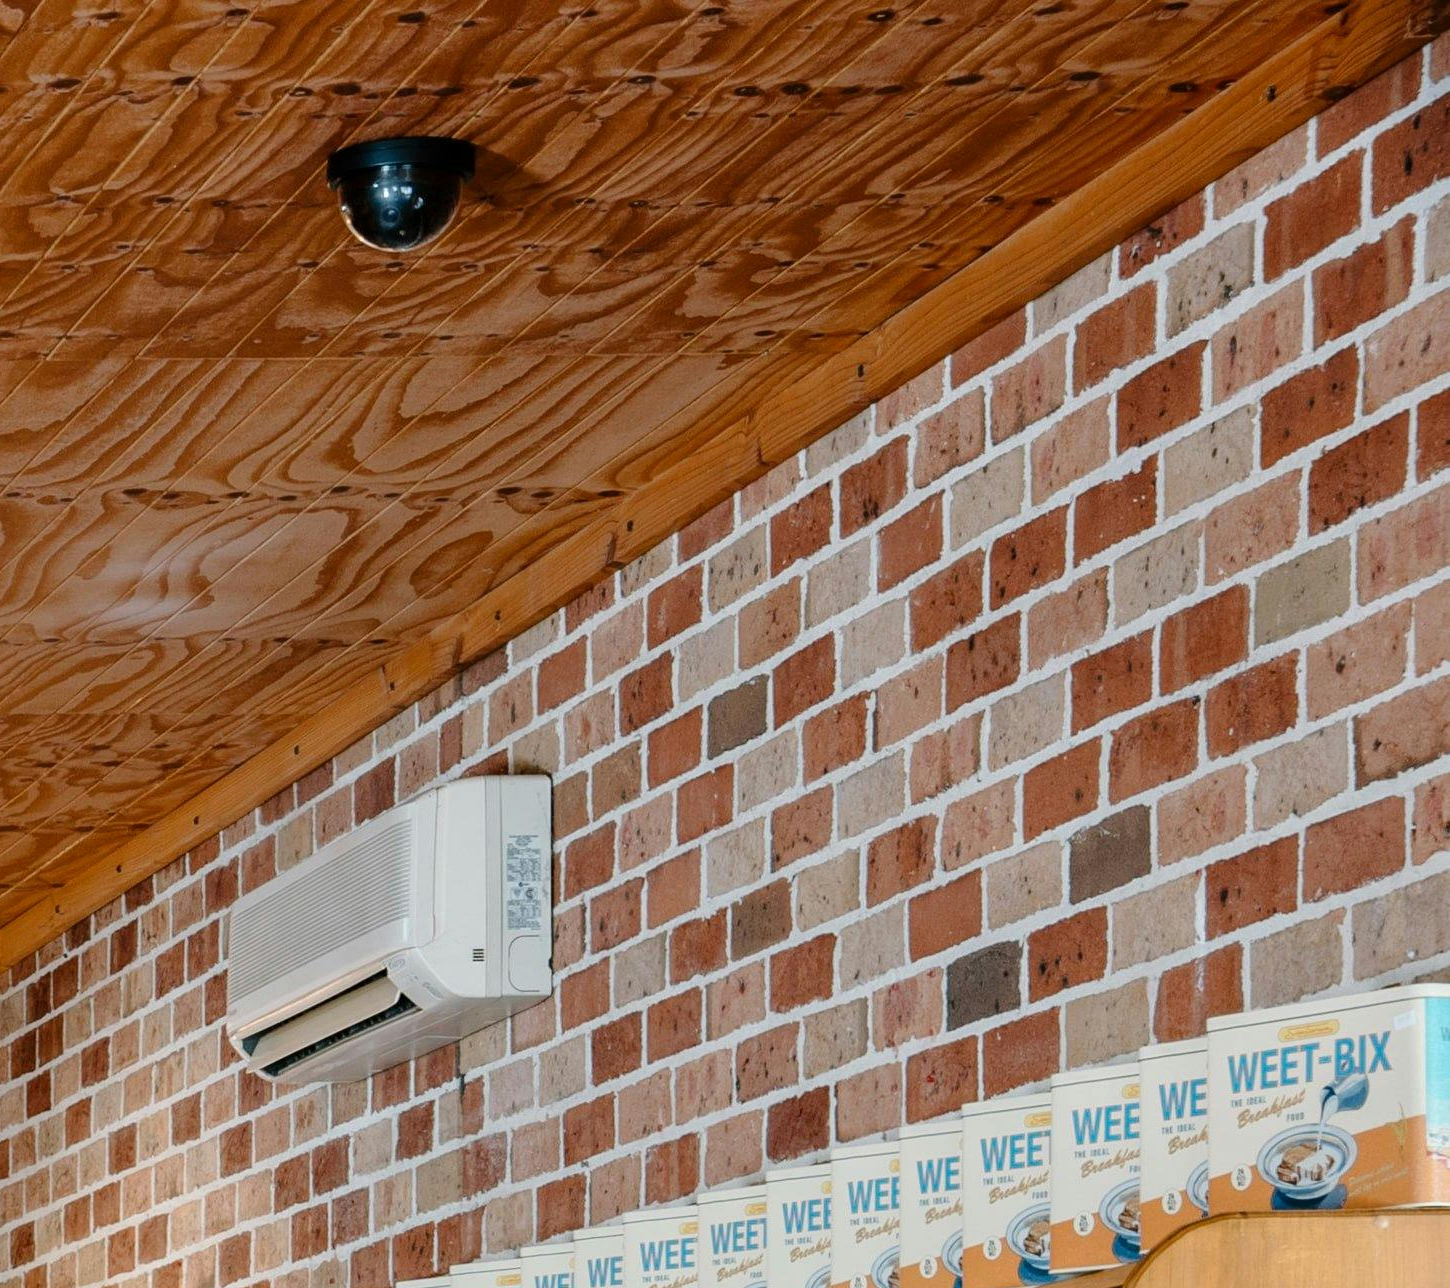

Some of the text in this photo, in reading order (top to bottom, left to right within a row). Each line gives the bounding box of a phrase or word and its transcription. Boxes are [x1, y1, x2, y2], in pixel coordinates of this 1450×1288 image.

[1227, 1031, 1392, 1094] WEET-BIX
[1231, 1096, 1266, 1107] THE IDEAL
[1237, 1090, 1306, 1128] Breakfast
[1162, 1124, 1196, 1135] THE IDEAL
[1287, 1112, 1305, 1122] FOOD
[1081, 1149, 1139, 1177] Breakfas
[1090, 1148, 1109, 1157] IDEAL
[989, 1172, 1050, 1204] Breakfast
[710, 1217, 767, 1255] WEET
[717, 1255, 762, 1282] Breakfast
